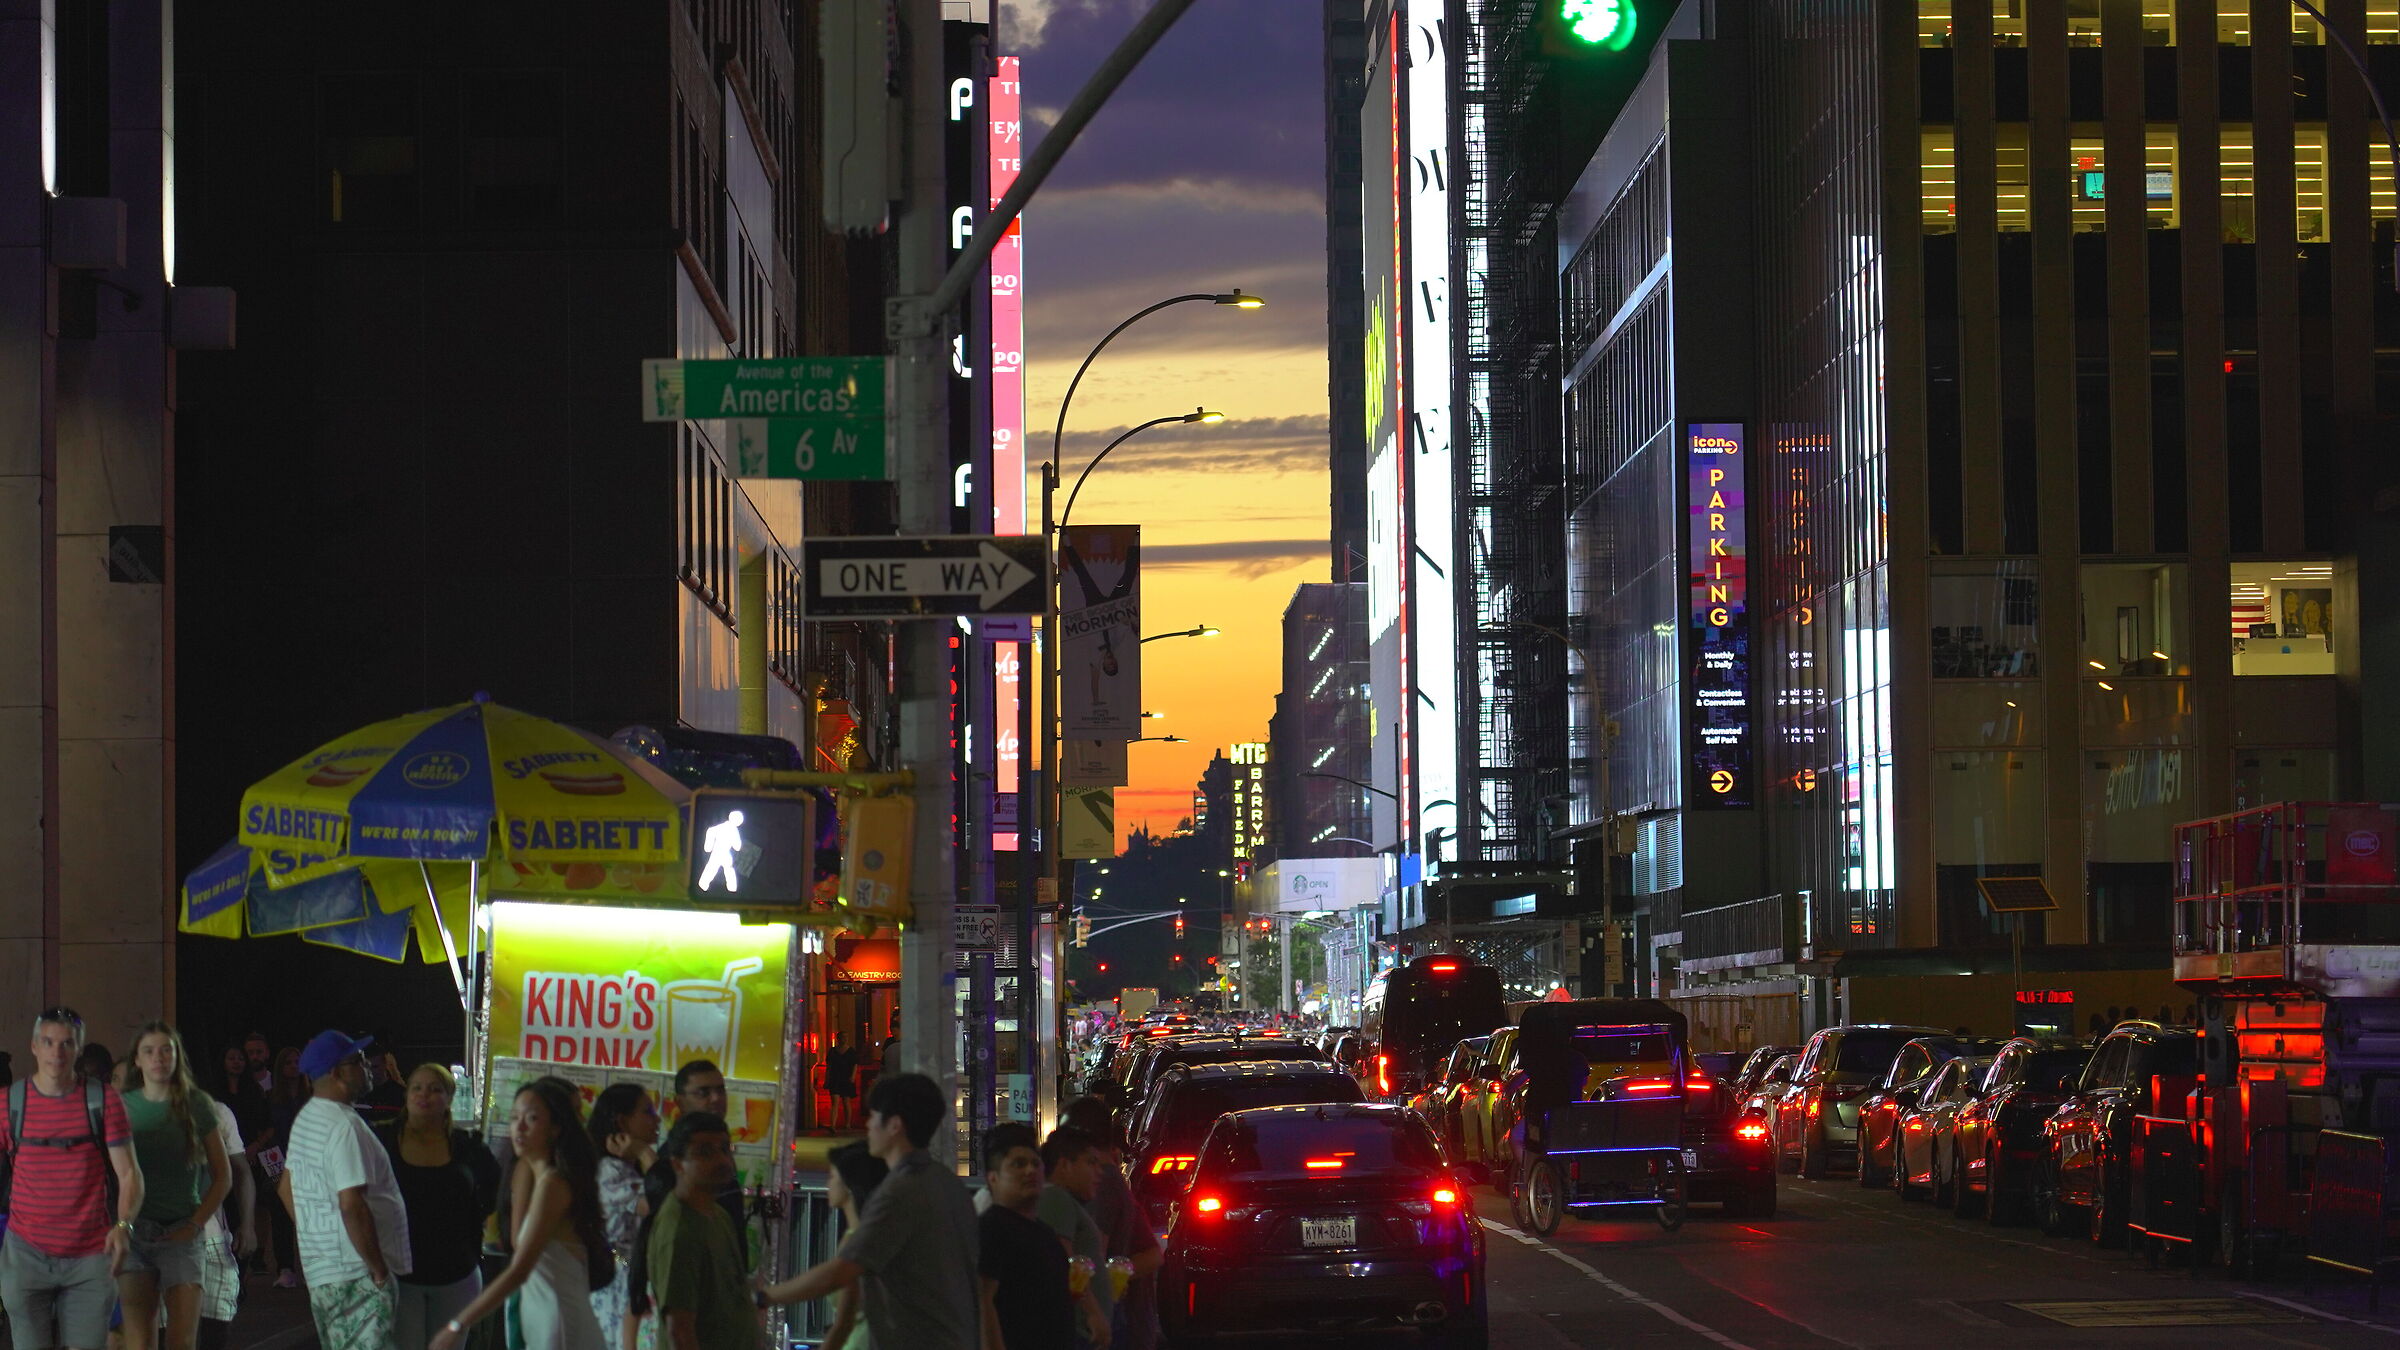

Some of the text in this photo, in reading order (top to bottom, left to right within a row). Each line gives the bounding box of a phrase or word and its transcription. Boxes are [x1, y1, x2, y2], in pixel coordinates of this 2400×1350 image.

[736, 364, 833, 379] Avenue of the
[720, 383, 850, 413] Americas
[795, 428, 858, 471] 6 Av
[1693, 435, 1725, 448] icon
[1708, 469, 1728, 626] PARKING
[840, 562, 1010, 592] ONE WAY
[1064, 605, 1138, 637] MORMON
[1704, 652, 1735, 660] Monthly
[1714, 661, 1733, 669] Daily
[1699, 689, 1742, 697] Contactless
[1701, 727, 1742, 735] Automated
[1705, 736, 1738, 744] Self Park
[1230, 743, 1266, 765] MTC
[503, 751, 601, 780] SABRETT
[245, 804, 345, 844] SABRETT
[361, 825, 398, 840] WE'RE
[402, 826, 419, 840] ON
[420, 826, 430, 840] A
[508, 820, 670, 850] SABRETT
[1309, 881, 1329, 889] OPEN
[527, 976, 655, 1031] KING'S
